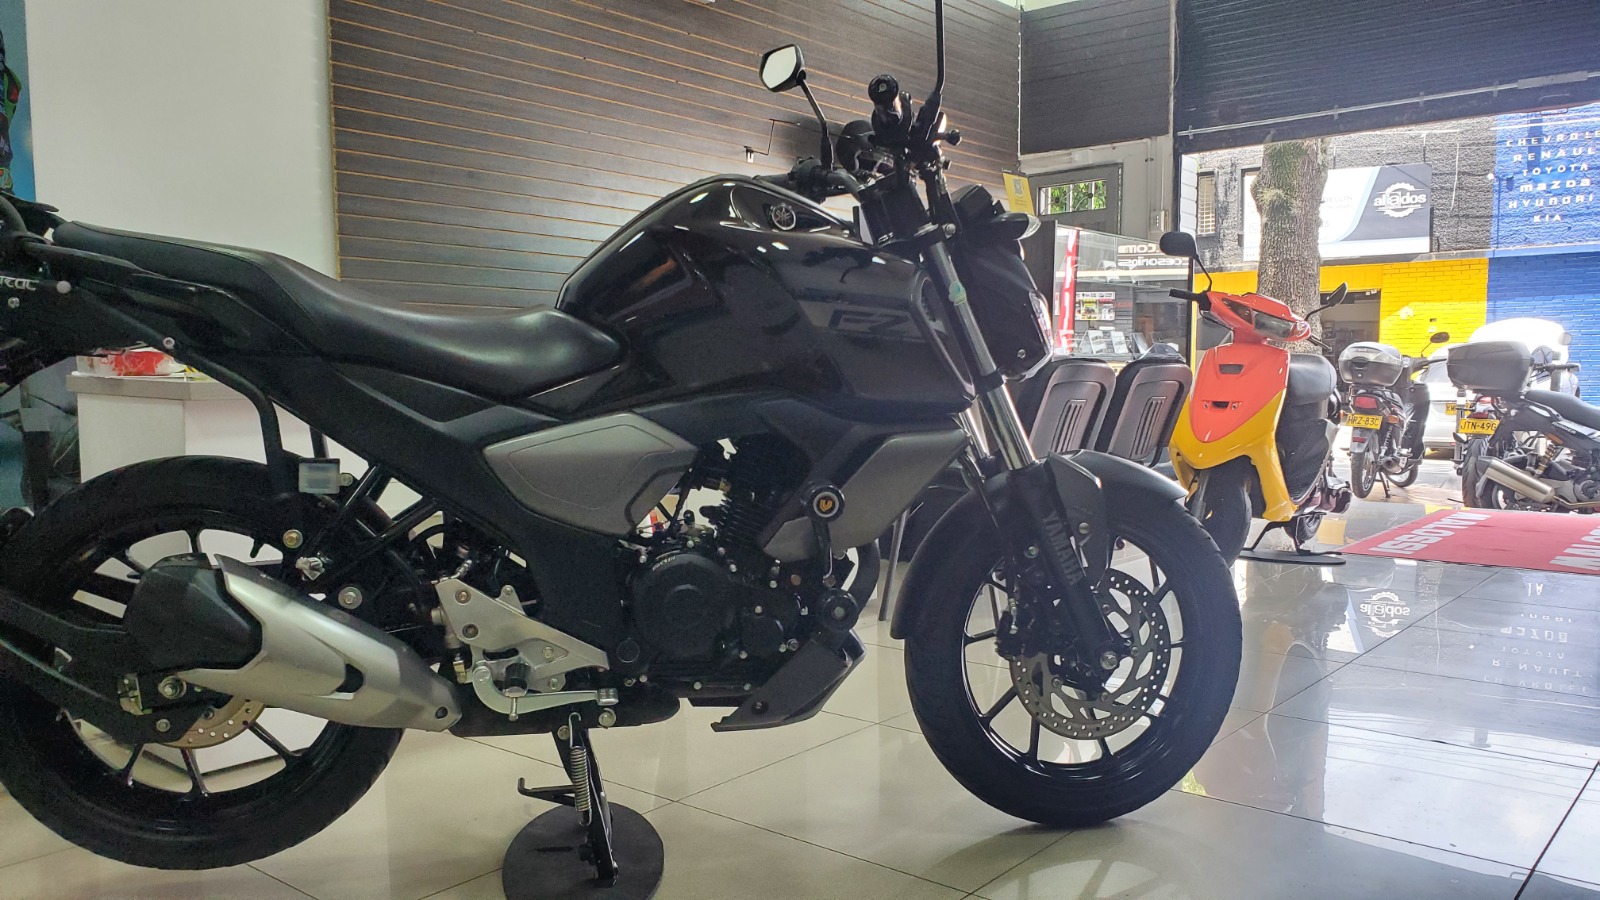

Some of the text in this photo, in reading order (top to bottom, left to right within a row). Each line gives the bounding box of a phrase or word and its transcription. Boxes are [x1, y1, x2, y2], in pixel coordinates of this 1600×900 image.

[1522, 163, 1589, 177] TOYOTA
[1533, 214, 1562, 223] KIA
[1368, 511, 1492, 555] MALOSSI
[1042, 510, 1084, 586] YAMAHA
